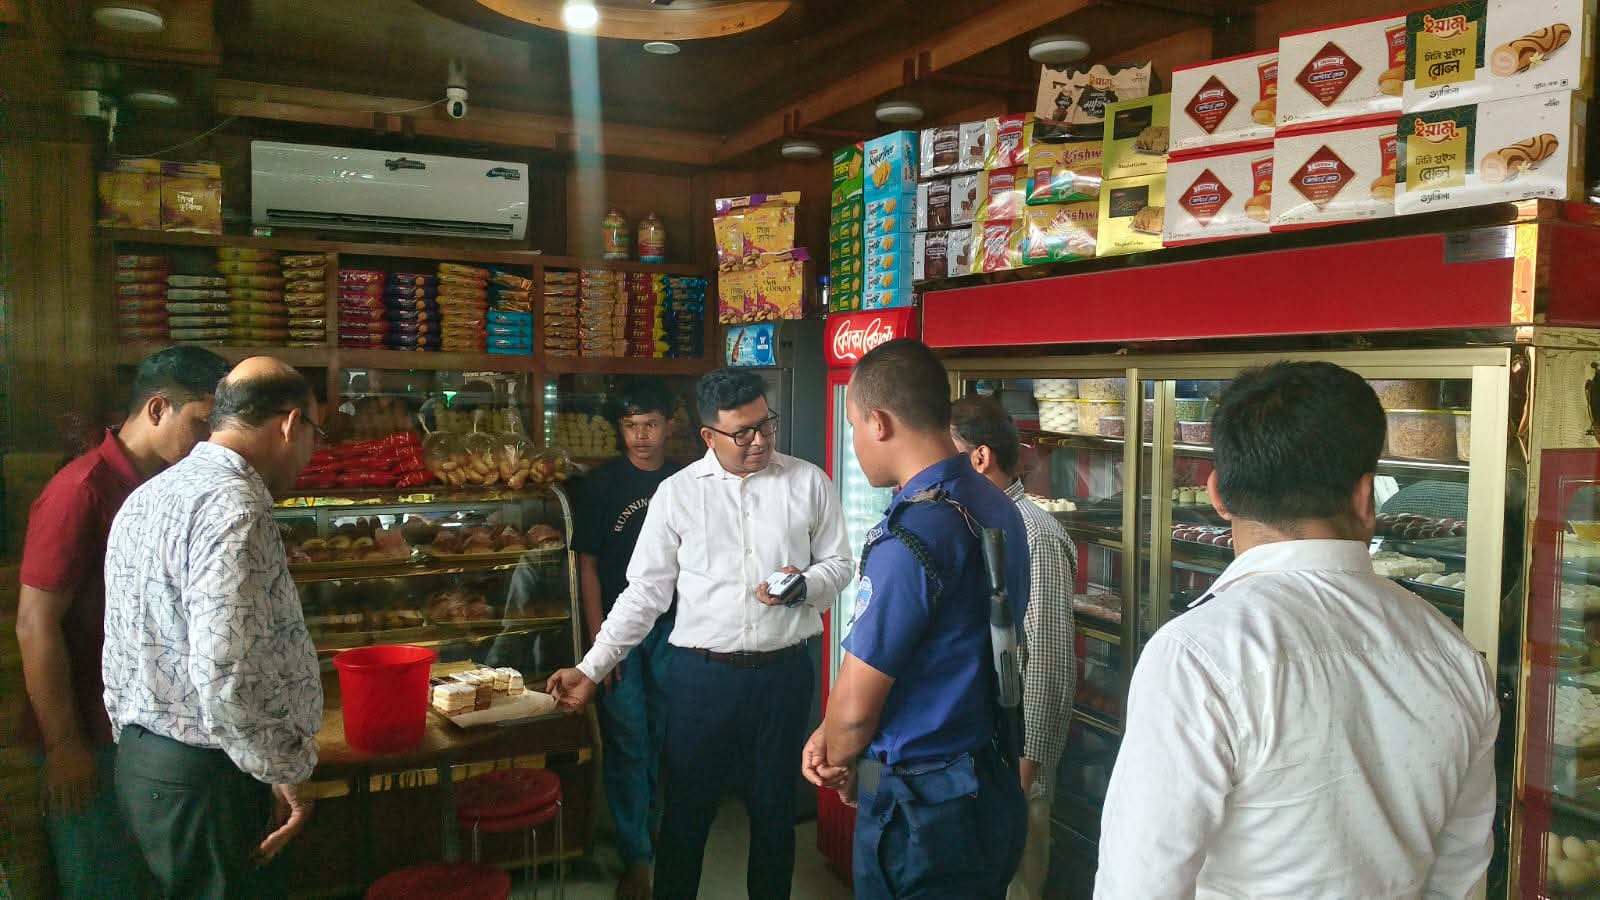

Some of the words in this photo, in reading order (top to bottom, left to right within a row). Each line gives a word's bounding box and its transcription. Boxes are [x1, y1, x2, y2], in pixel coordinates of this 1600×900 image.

[1425, 51, 1442, 62] মিনি
[1443, 48, 1466, 60] সুইস
[1428, 60, 1460, 79] রোল
[1055, 148, 1103, 165] Kishw
[1051, 207, 1099, 226] Kishw
[614, 498, 648, 531] RUNNIN
